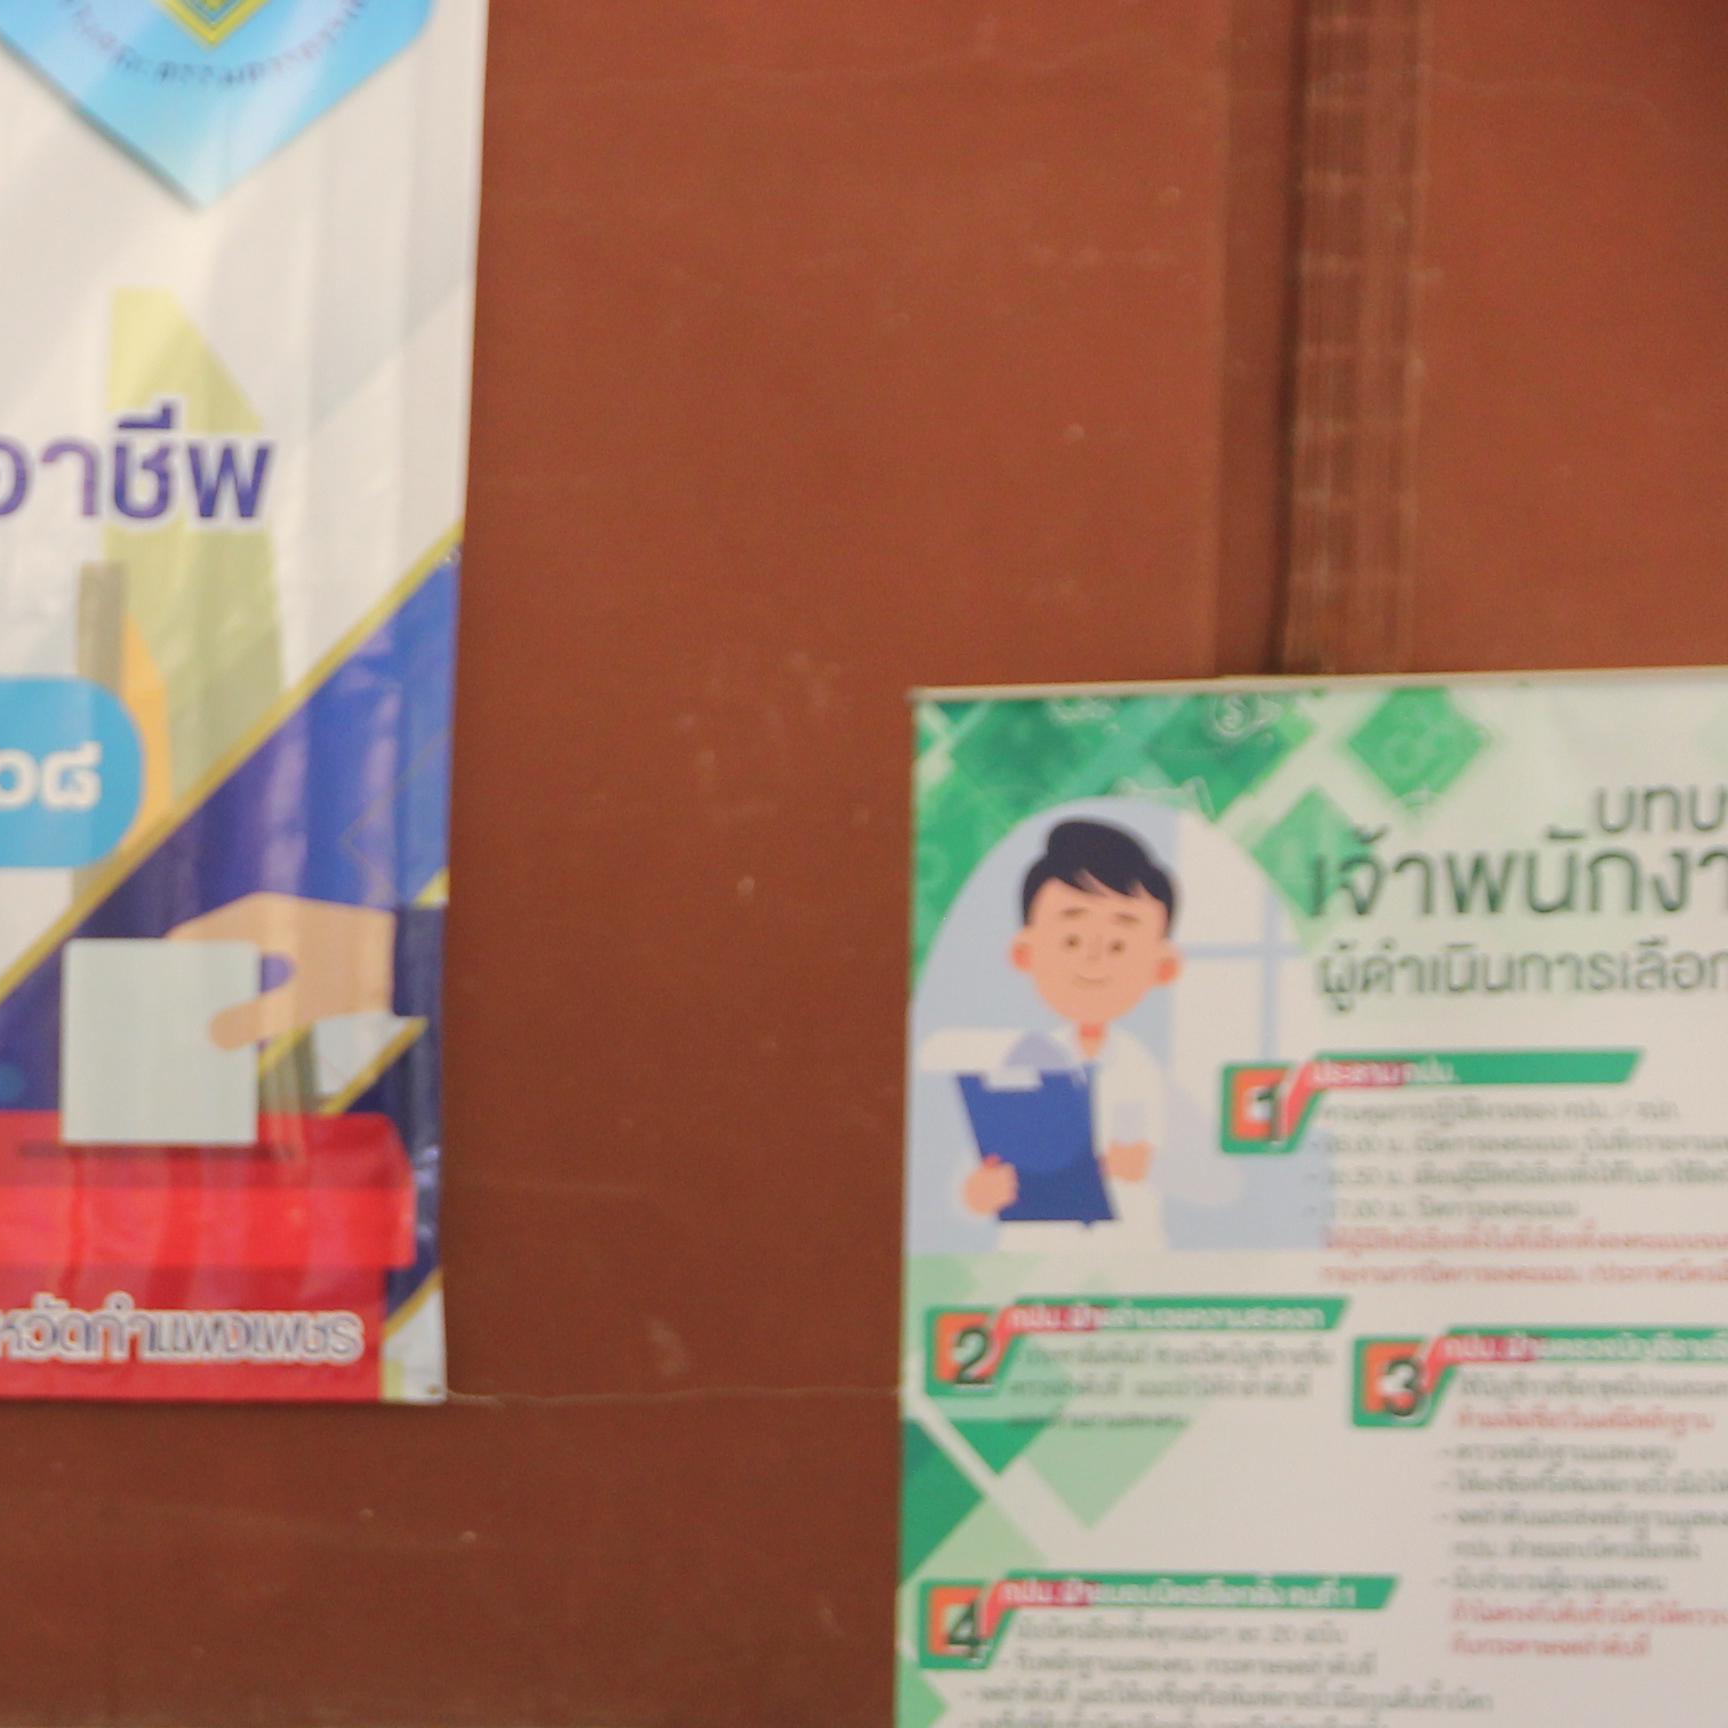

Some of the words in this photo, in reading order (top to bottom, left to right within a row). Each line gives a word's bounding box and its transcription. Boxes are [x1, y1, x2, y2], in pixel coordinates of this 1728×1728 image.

[952, 1328, 990, 1385] 2
[1384, 1355, 1427, 1421] 3
[945, 1602, 990, 1660] 4
